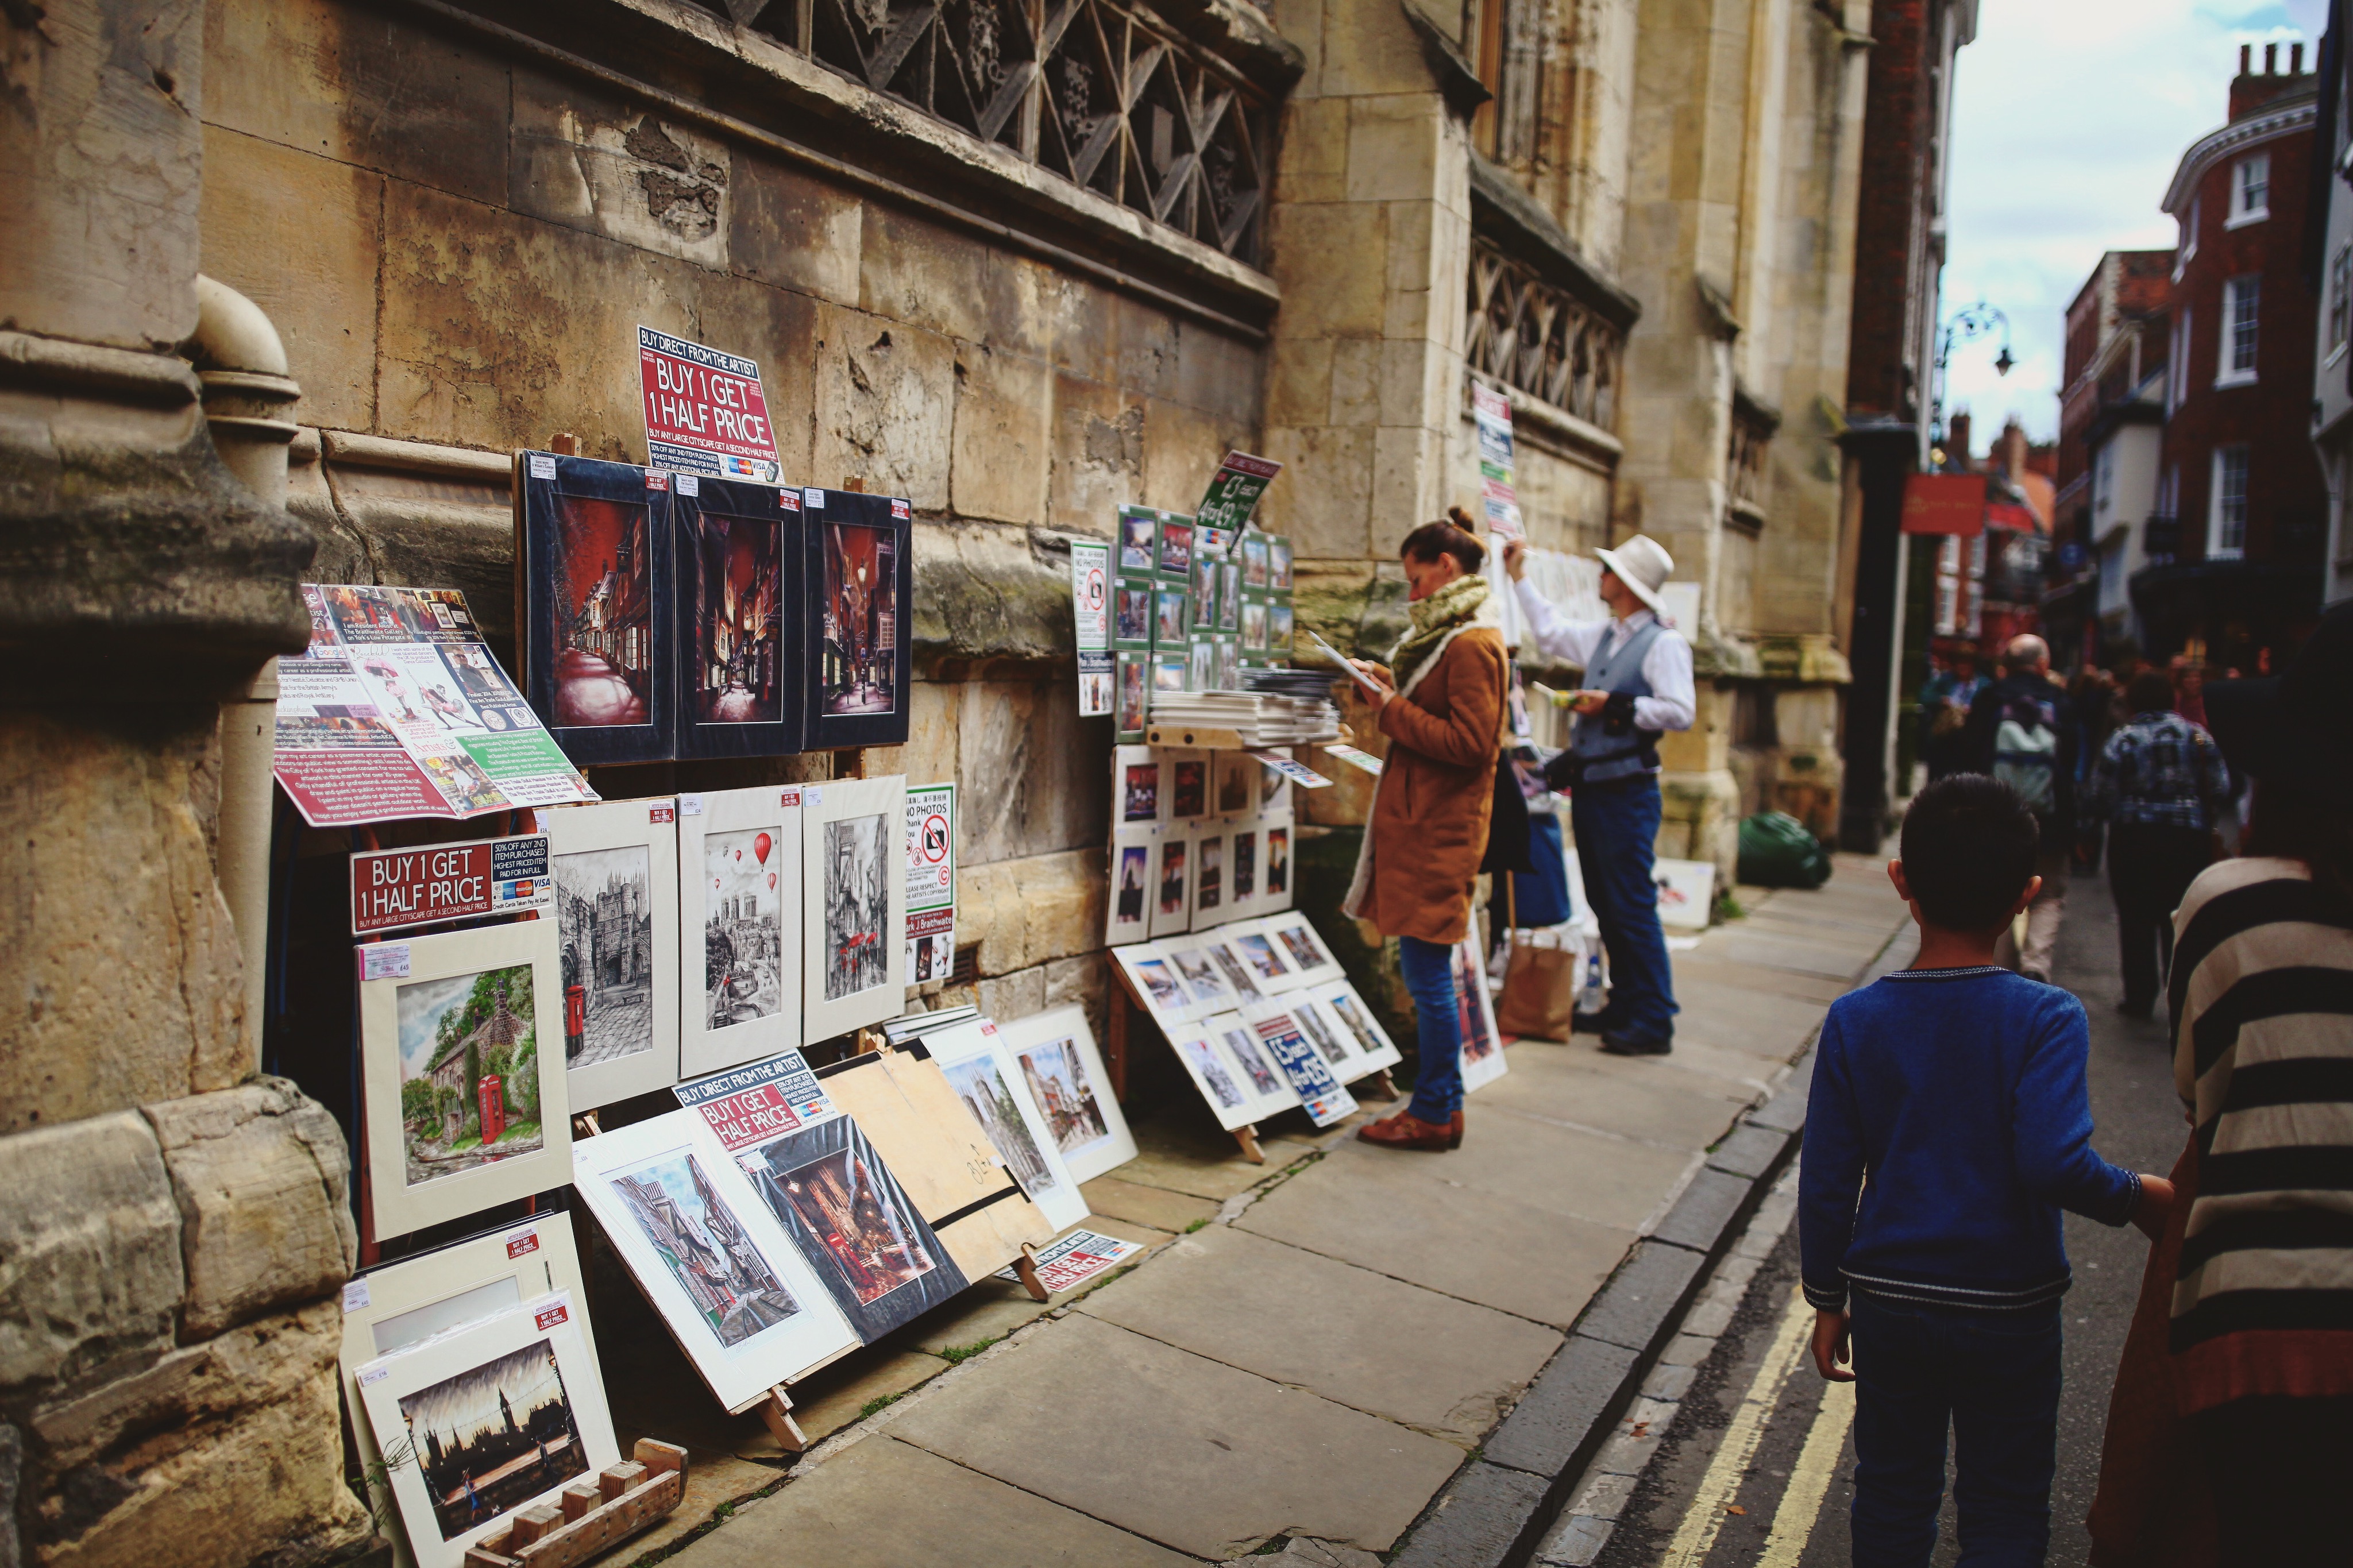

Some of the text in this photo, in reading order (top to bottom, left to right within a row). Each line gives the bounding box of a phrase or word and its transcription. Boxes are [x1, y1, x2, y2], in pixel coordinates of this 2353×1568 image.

[641, 329, 754, 376] BUY DIRECT FROM THE ARTIST
[656, 357, 693, 397] BUY
[699, 370, 707, 400] 1
[711, 374, 747, 410] GET
[649, 391, 769, 445] 1 HALF PRICE
[649, 427, 776, 459] BUY ANY LARGE CITYSCAPE GET A SECOND HALF PRICE
[651, 453, 667, 461] HIGHEST
[695, 452, 718, 462] PURCHASED
[679, 465, 701, 474] ADDITIONAL
[751, 461, 766, 470] VISA
[317, 647, 344, 657] Google
[916, 804, 947, 816] PHOTOS
[495, 839, 546, 852] 50% OFF ANY 2ND
[495, 848, 545, 860] ITEM PURCHASED
[372, 849, 472, 886] BUY 1 GET
[493, 860, 515, 870] HIGHEST
[516, 859, 534, 867] PRICED
[534, 878, 550, 887] VISA
[906, 882, 937, 893] LEASE RESPECT
[361, 875, 484, 917] 1 HALF PRICE
[927, 888, 949, 896] COPYRIGHT
[359, 919, 370, 928] BUY
[371, 917, 381, 925] ANY
[381, 915, 398, 924] LARGE
[399, 911, 425, 921] CITYSCAPE
[426, 909, 436, 917] GET
[441, 906, 461, 915] SECOND
[462, 903, 474, 912] HALF
[475, 902, 487, 910] PRICE
[916, 920, 919, 930] J
[920, 916, 951, 930] Braithwaite
[680, 1055, 801, 1103] BUY DIRECT FROM THE ARTIST
[703, 1089, 770, 1124] BUY 1 GET
[817, 1098, 830, 1106] VISA
[716, 1104, 792, 1143] HALF PRICE
[519, 1229, 532, 1237] EXCLUSIVE
[523, 1243, 534, 1251] PRICE
[1039, 1250, 1059, 1263] FROM
[1055, 1242, 1071, 1254] THE
[1069, 1233, 1091, 1246] ARTIST
[1054, 1256, 1081, 1268] GET
[1047, 1270, 1077, 1285] HALF
[1069, 1257, 1104, 1273] PRICE
